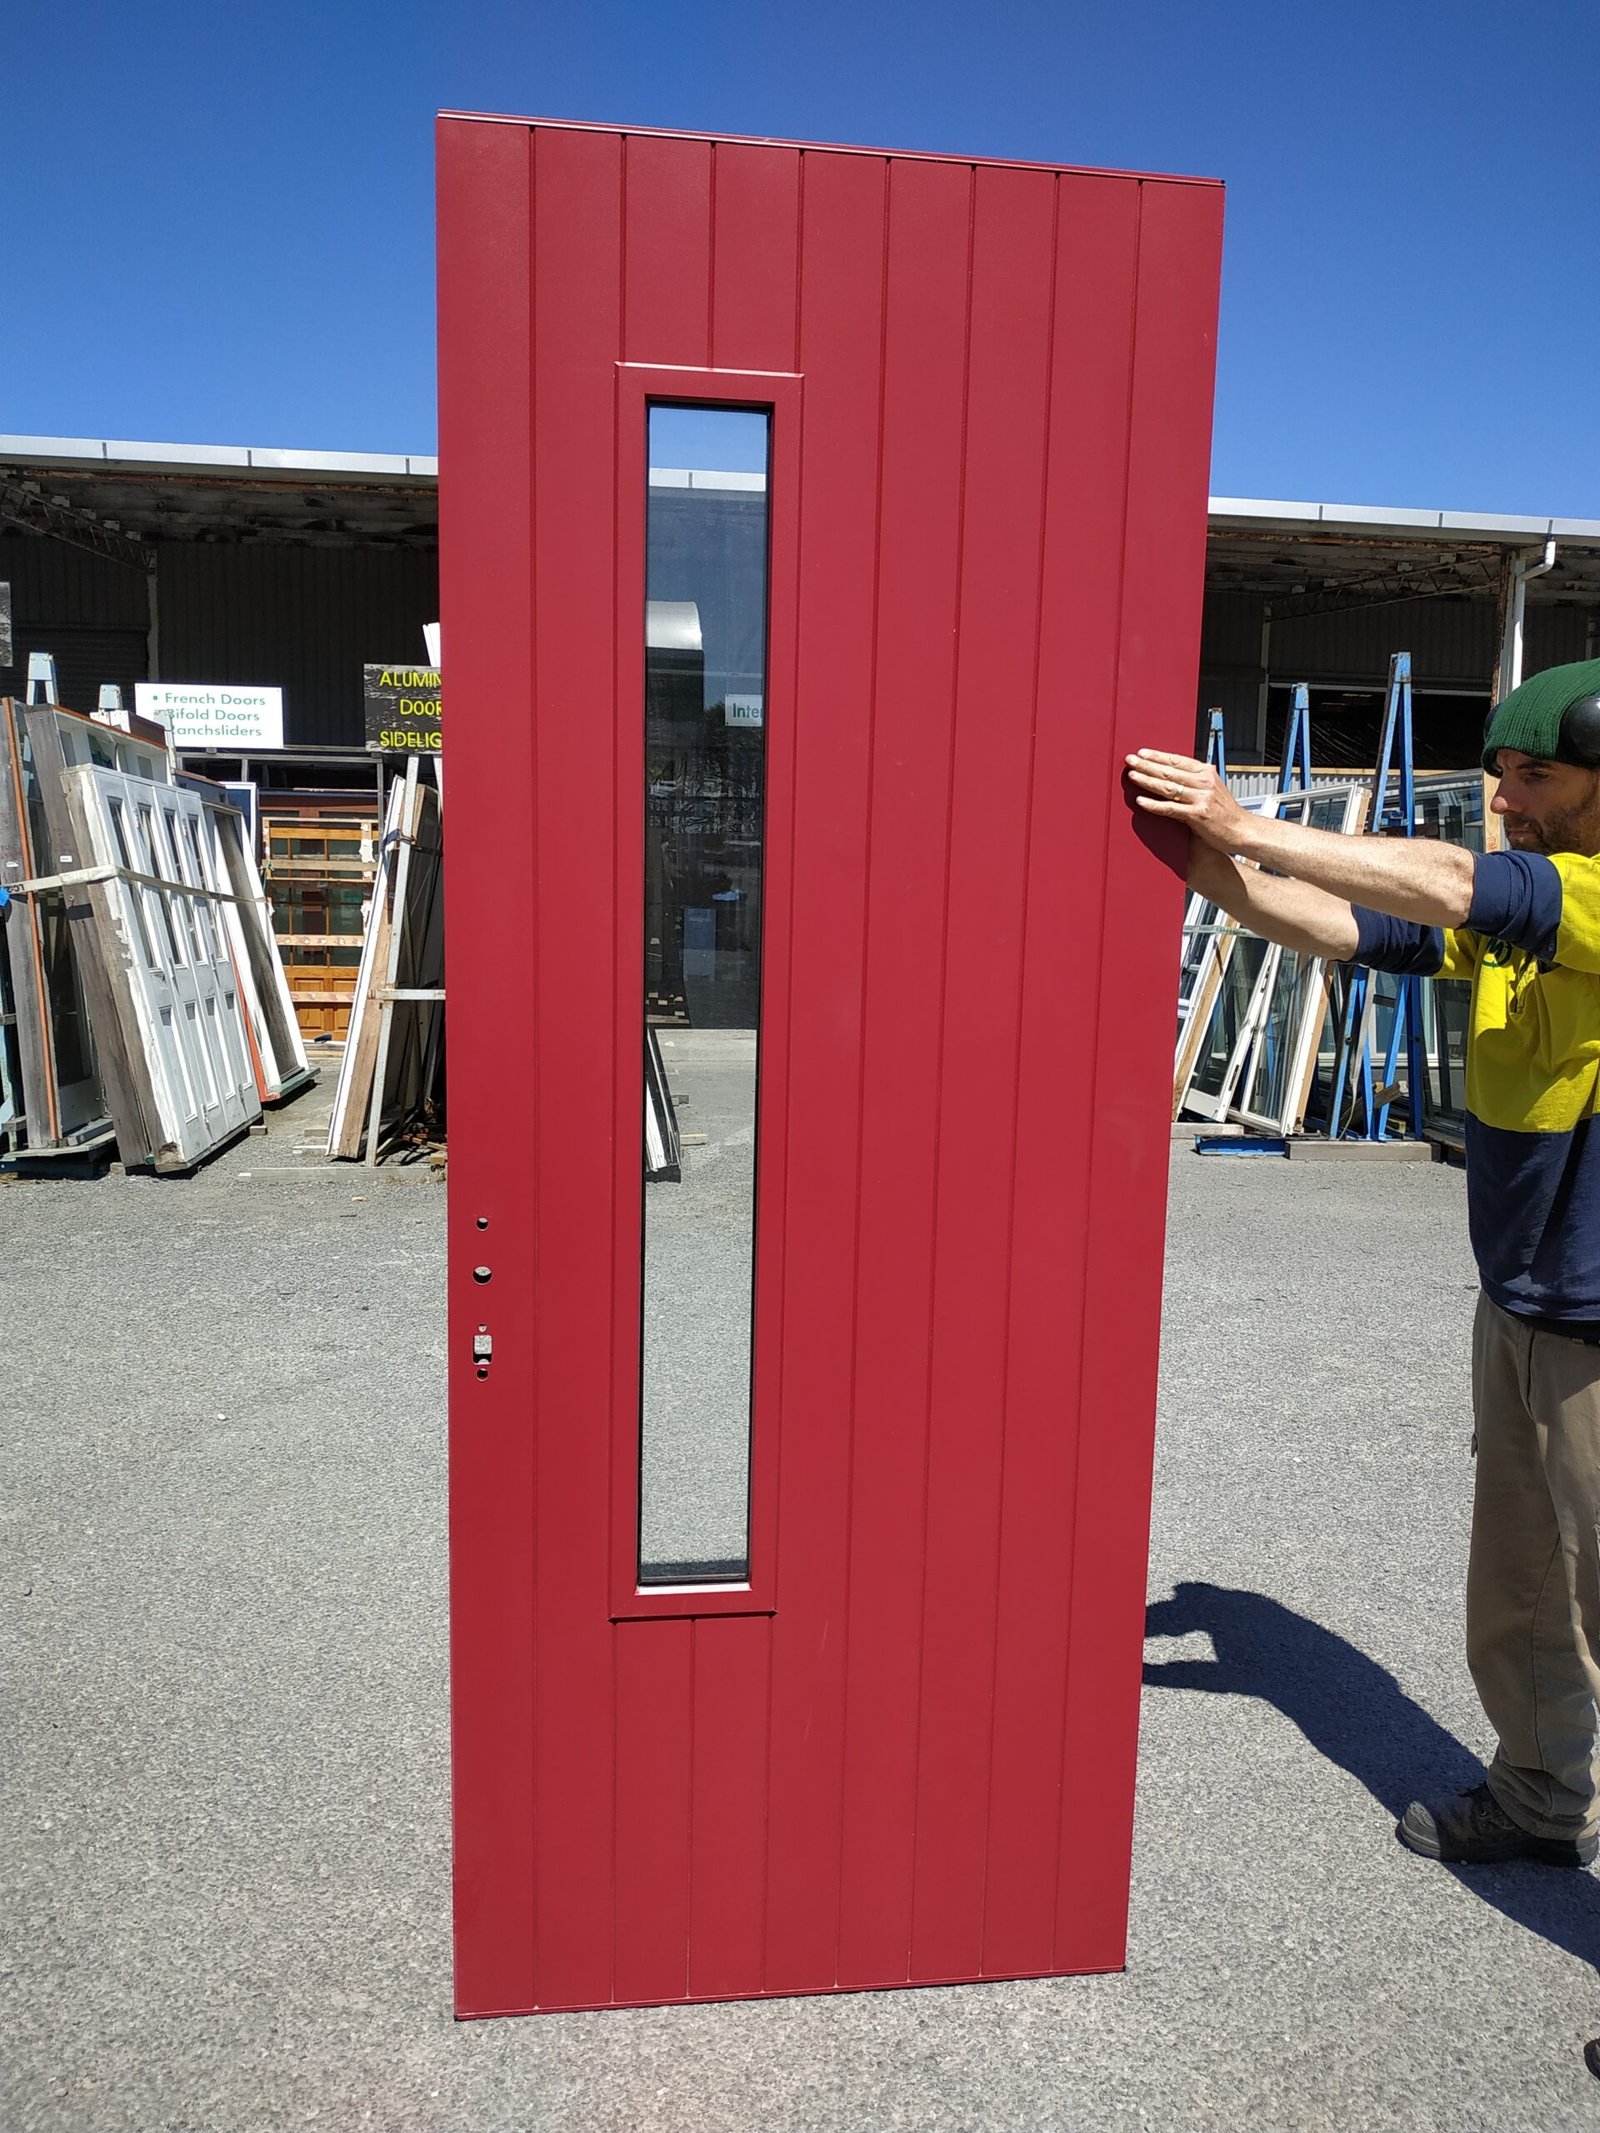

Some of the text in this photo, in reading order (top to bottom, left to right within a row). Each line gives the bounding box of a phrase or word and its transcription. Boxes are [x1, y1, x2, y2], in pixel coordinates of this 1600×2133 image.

[165, 692, 266, 706] French Doors
[215, 709, 260, 721] Doors
[171, 724, 262, 737] anchsliders
